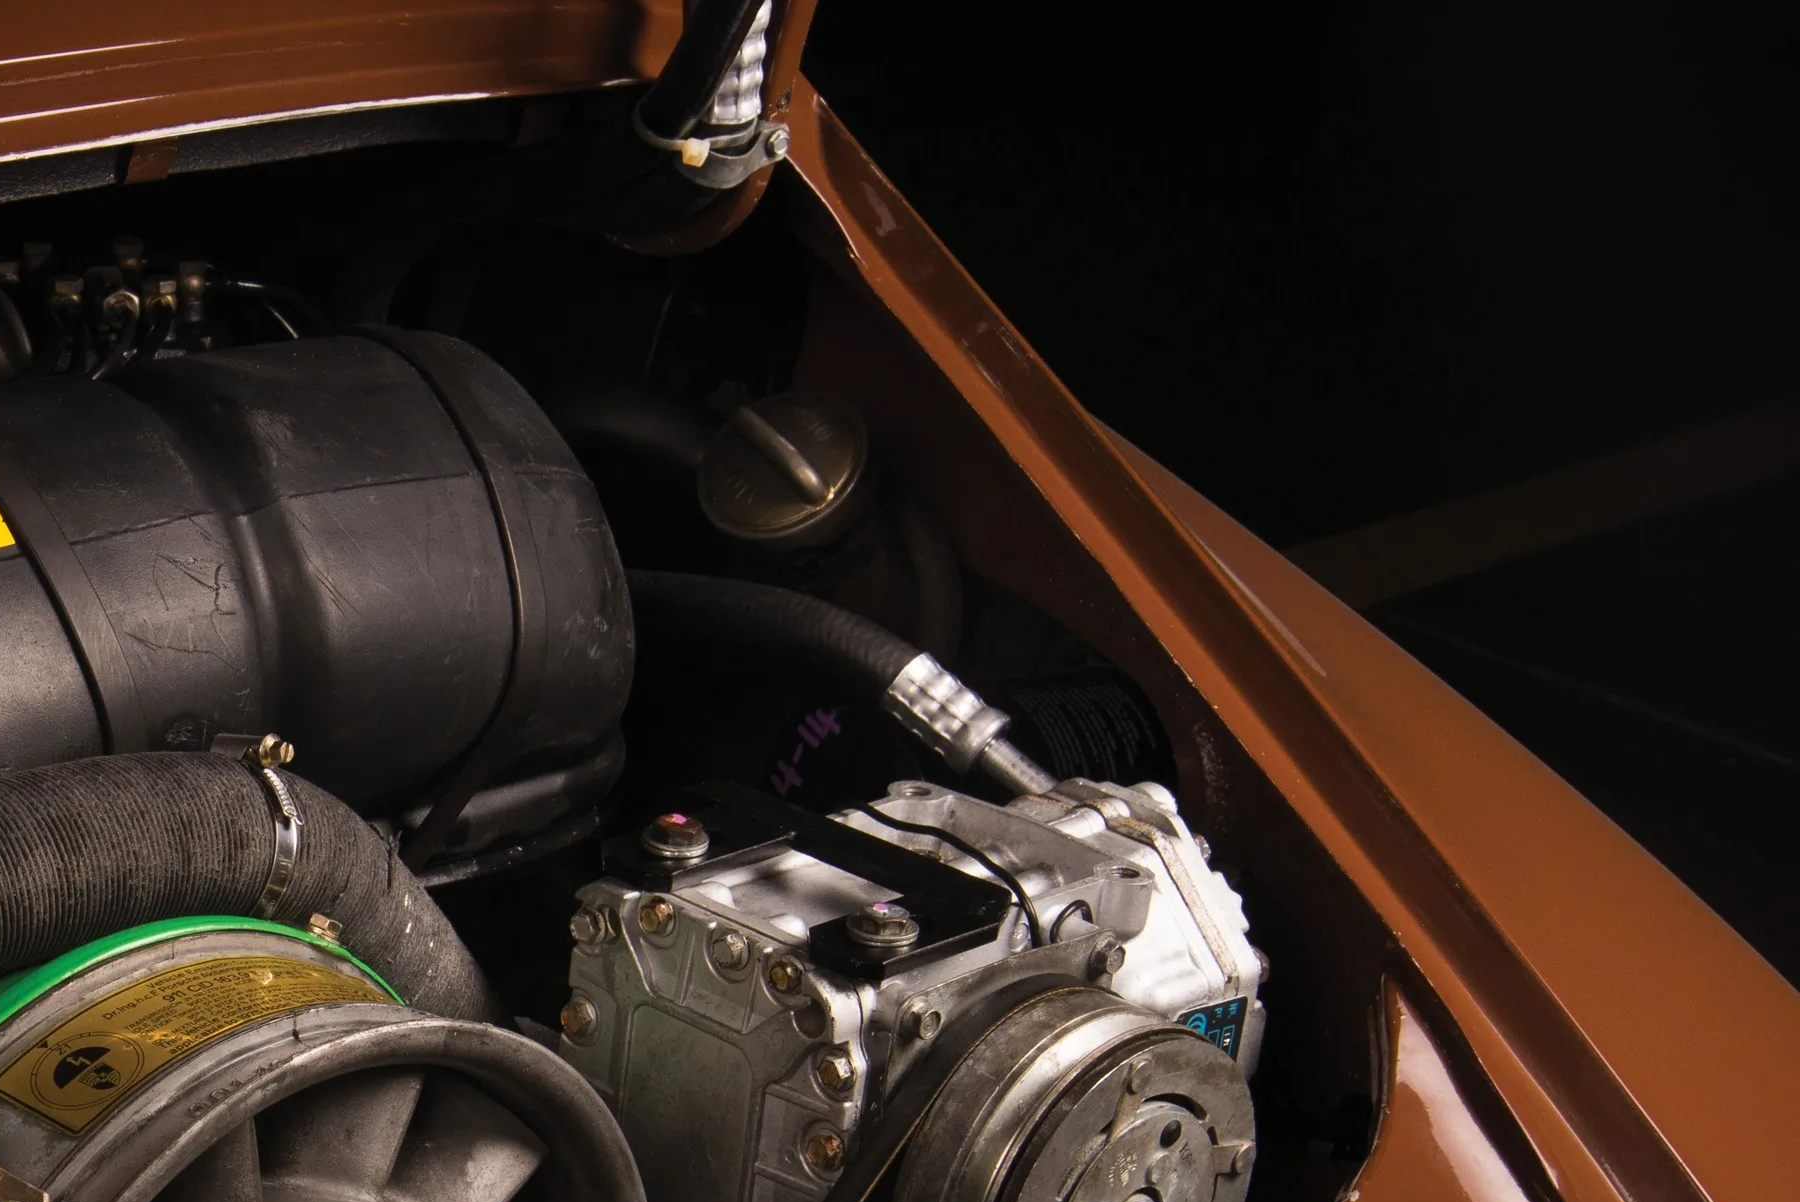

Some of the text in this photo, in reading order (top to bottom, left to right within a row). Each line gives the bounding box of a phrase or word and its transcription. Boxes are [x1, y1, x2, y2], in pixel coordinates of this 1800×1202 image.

[146, 972, 186, 988] Vehicle
[161, 990, 186, 1002] 911
[186, 981, 214, 991] CID
[183, 1017, 220, 1035] Vehicle
